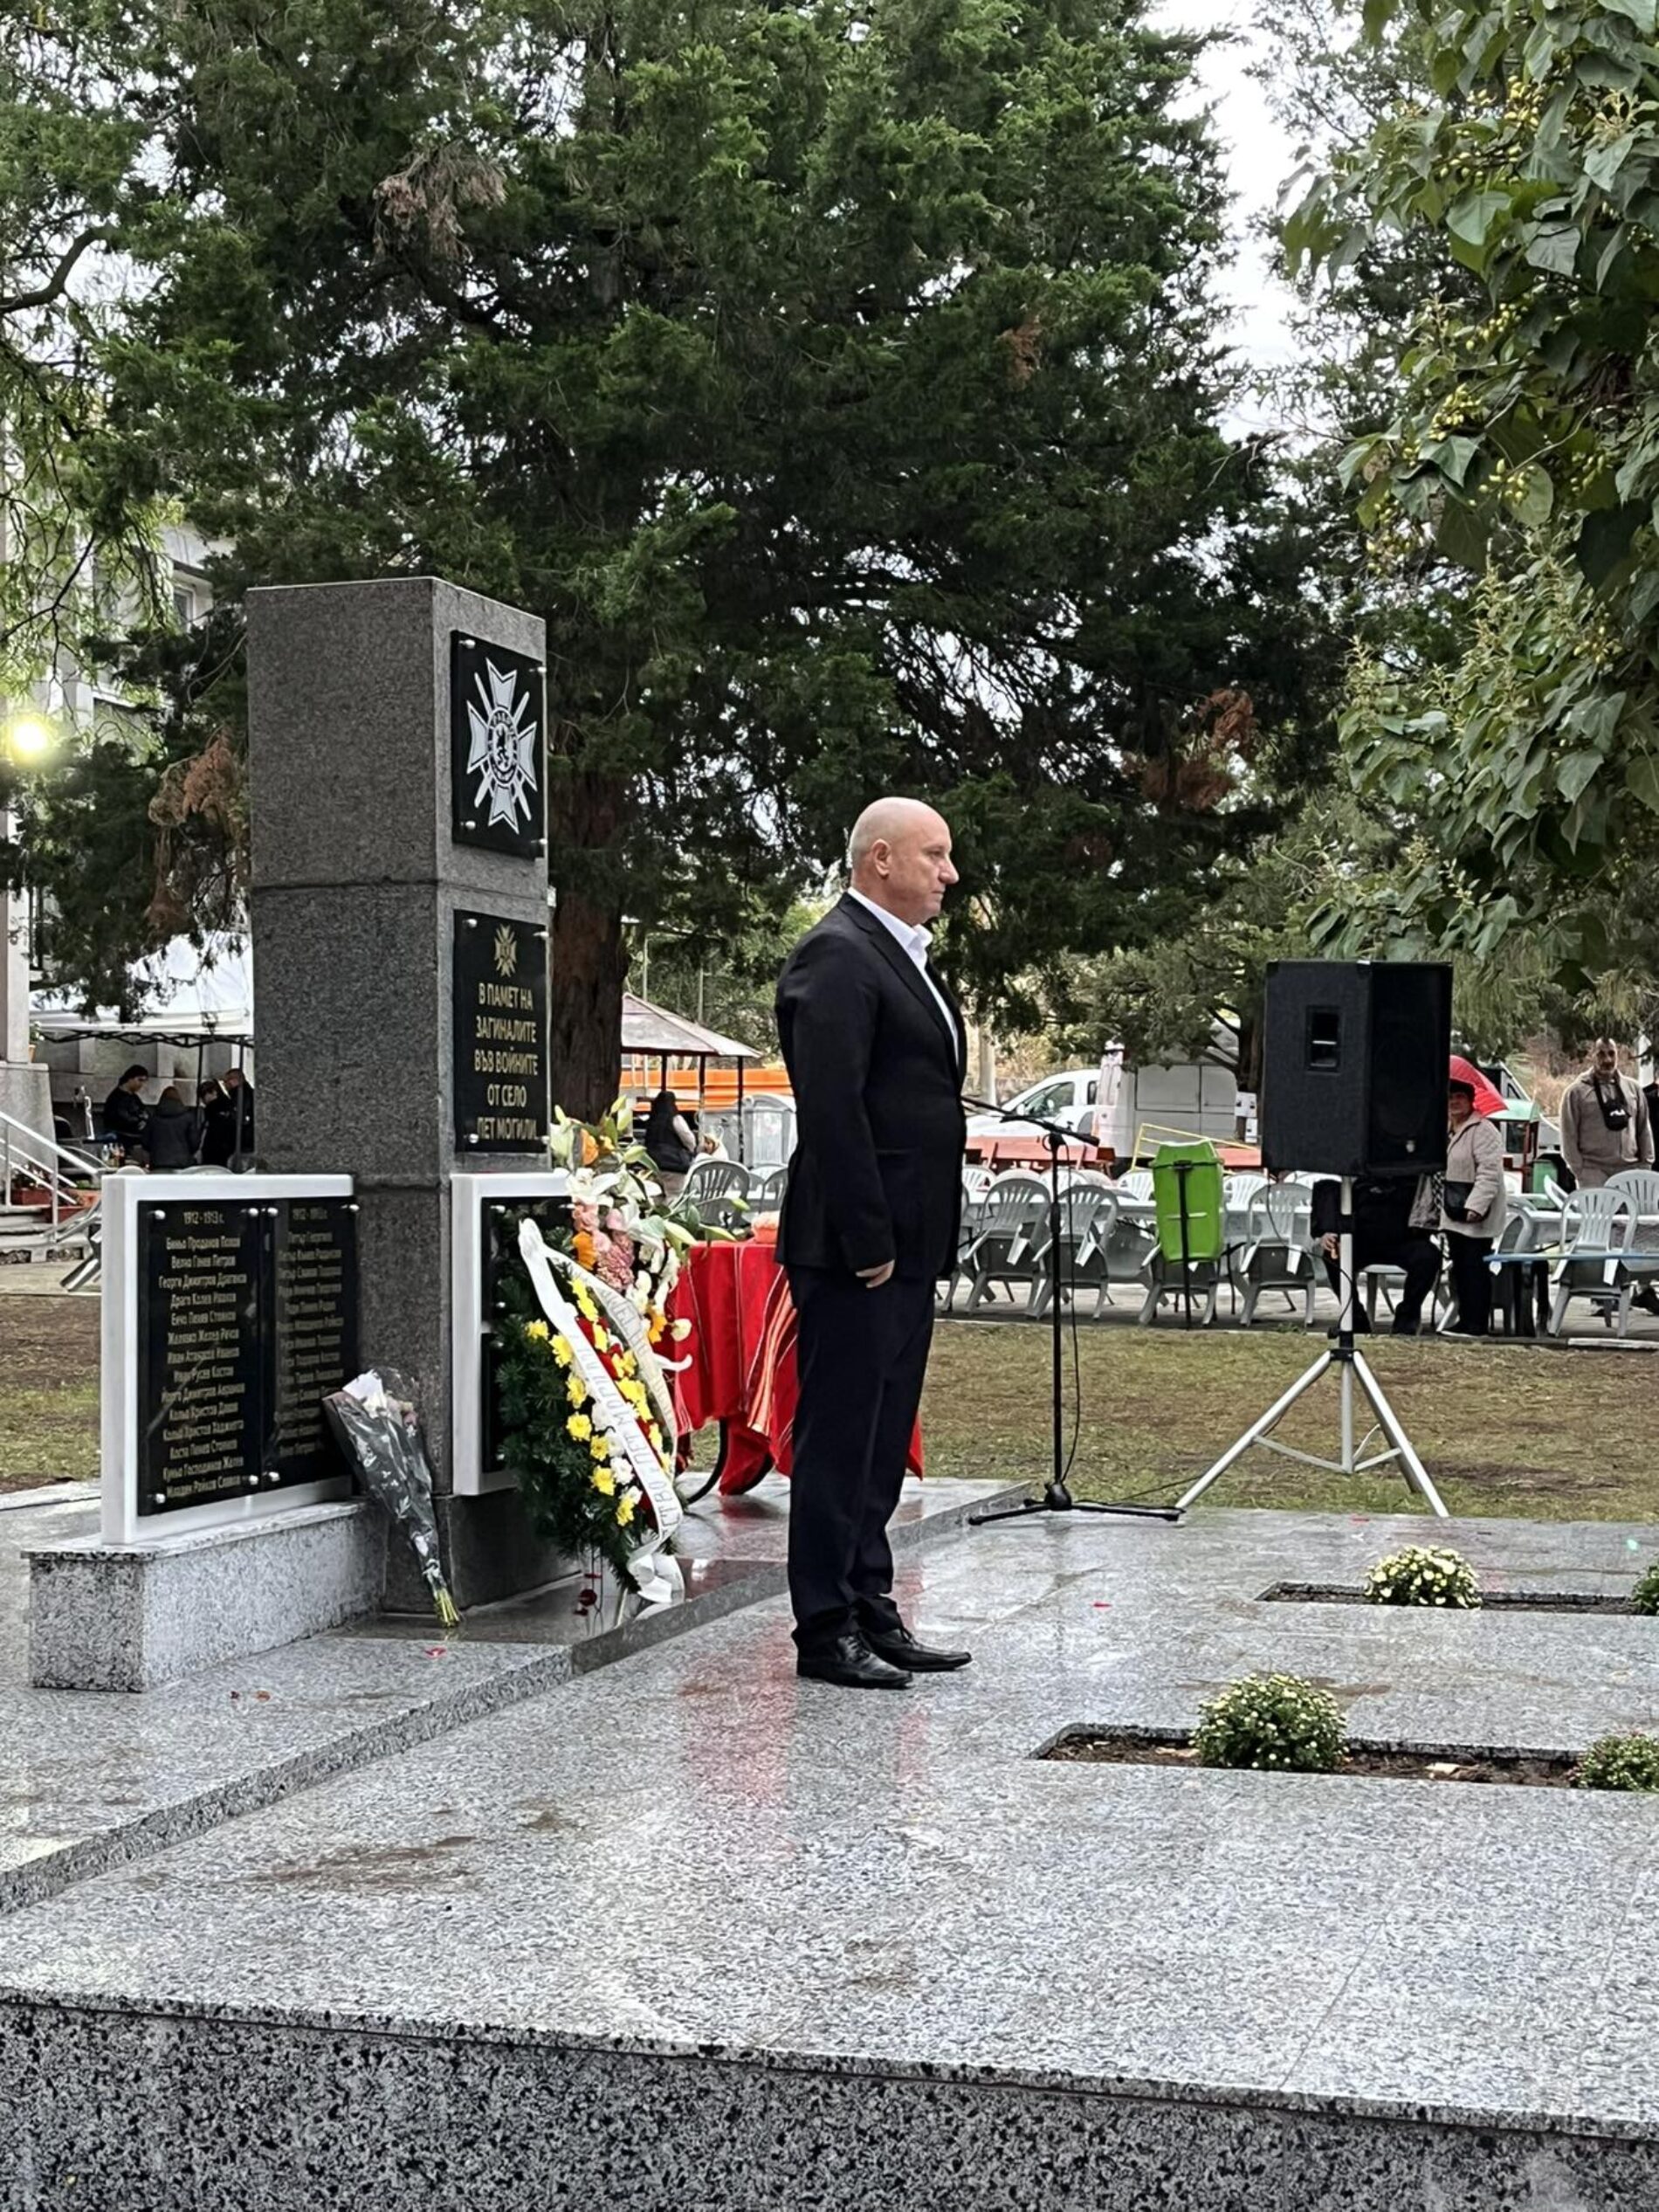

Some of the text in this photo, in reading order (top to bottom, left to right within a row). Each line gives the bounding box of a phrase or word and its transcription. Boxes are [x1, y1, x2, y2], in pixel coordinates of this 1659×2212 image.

[478, 982, 534, 1011] В ПАМЕТ НА
[476, 1016, 537, 1044] ЗАГИНАЛИТЕ
[474, 1046, 539, 1076] ВЪВ ВОЙНИТЕ
[487, 1084, 527, 1108] ОТ СЕЛО
[477, 1116, 496, 1139] ПЕТ
